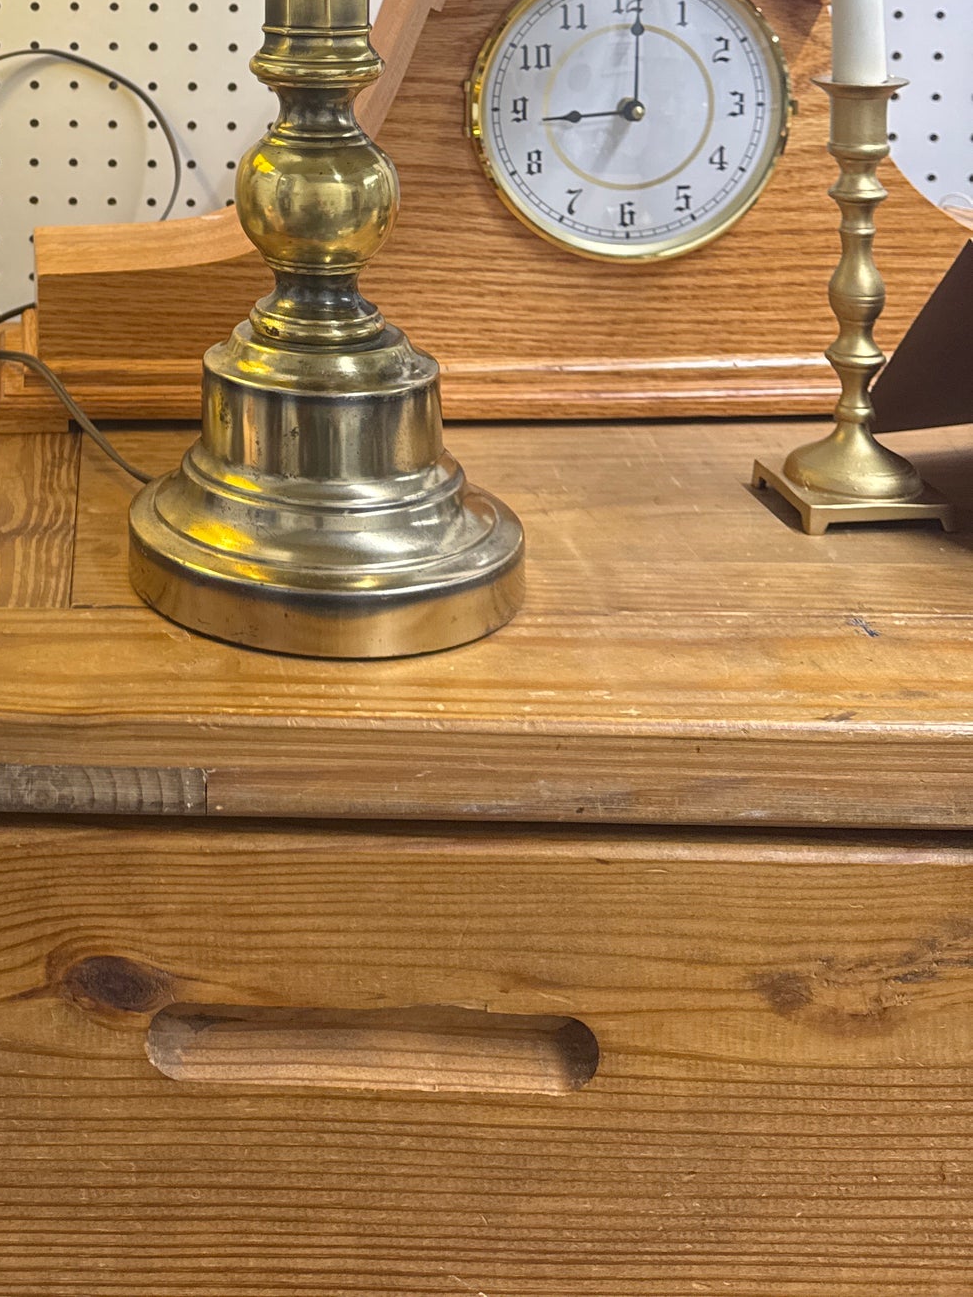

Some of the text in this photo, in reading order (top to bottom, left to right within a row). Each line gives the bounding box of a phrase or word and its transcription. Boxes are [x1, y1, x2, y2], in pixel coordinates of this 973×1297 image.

[559, 3, 588, 30] 11
[677, 0, 689, 27] 1
[519, 43, 553, 70] 10
[712, 36, 731, 63] 2
[511, 96, 529, 123] 9
[727, 90, 746, 118] 3
[526, 149, 543, 176] 8
[709, 145, 729, 171] 4
[565, 188, 584, 215] 7
[673, 185, 692, 212] 5
[618, 201, 636, 228] 6
